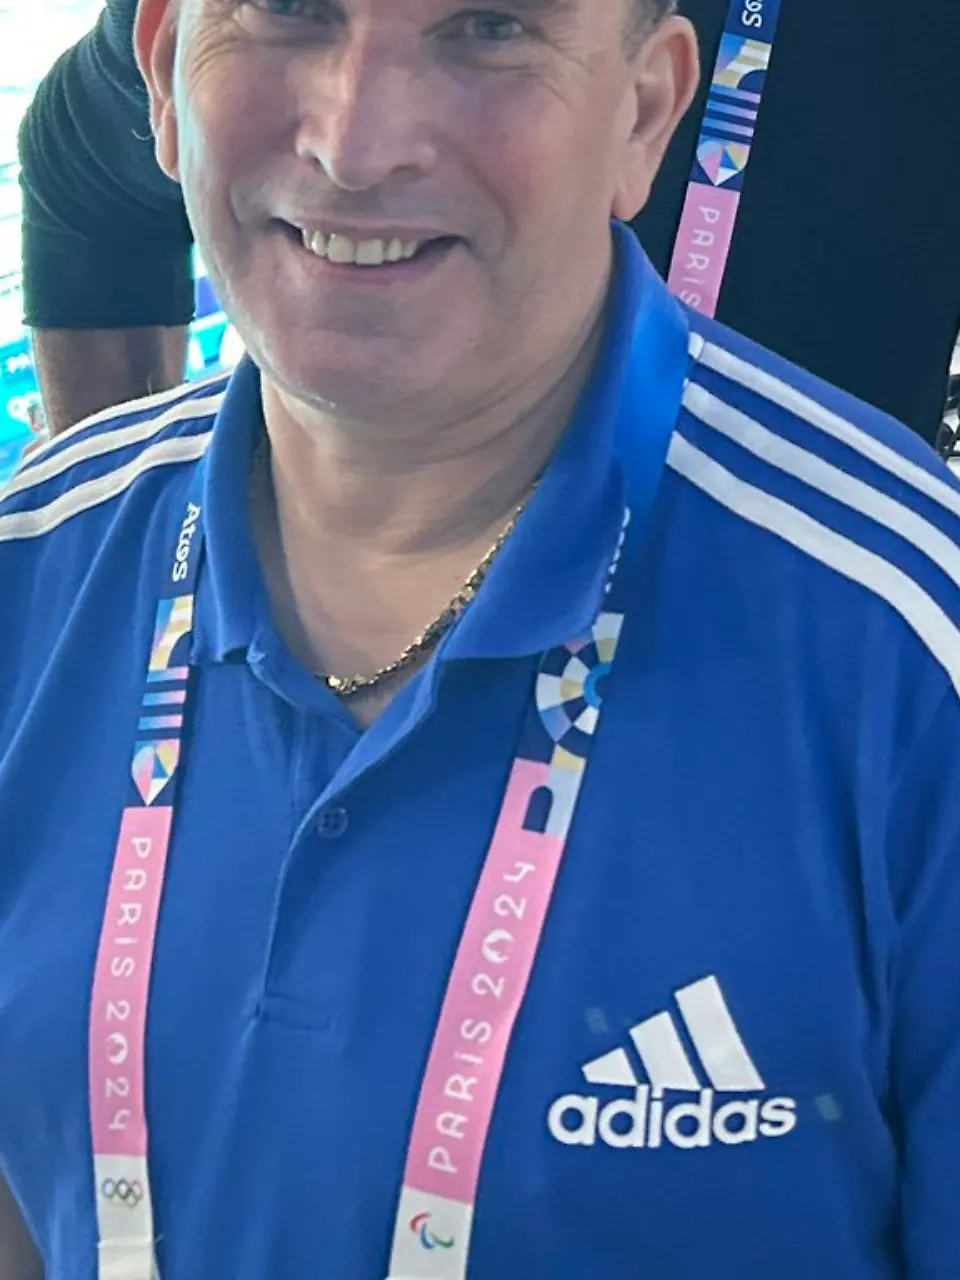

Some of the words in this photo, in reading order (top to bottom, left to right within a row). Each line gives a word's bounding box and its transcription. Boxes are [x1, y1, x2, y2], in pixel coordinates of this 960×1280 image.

[678, 204, 721, 310] PARIS
[110, 835, 153, 978] PARIS
[104, 999, 132, 1131] 2024
[427, 1018, 493, 1174] PARIS
[471, 859, 537, 999] 2024
[547, 1083, 797, 1149] adidas
